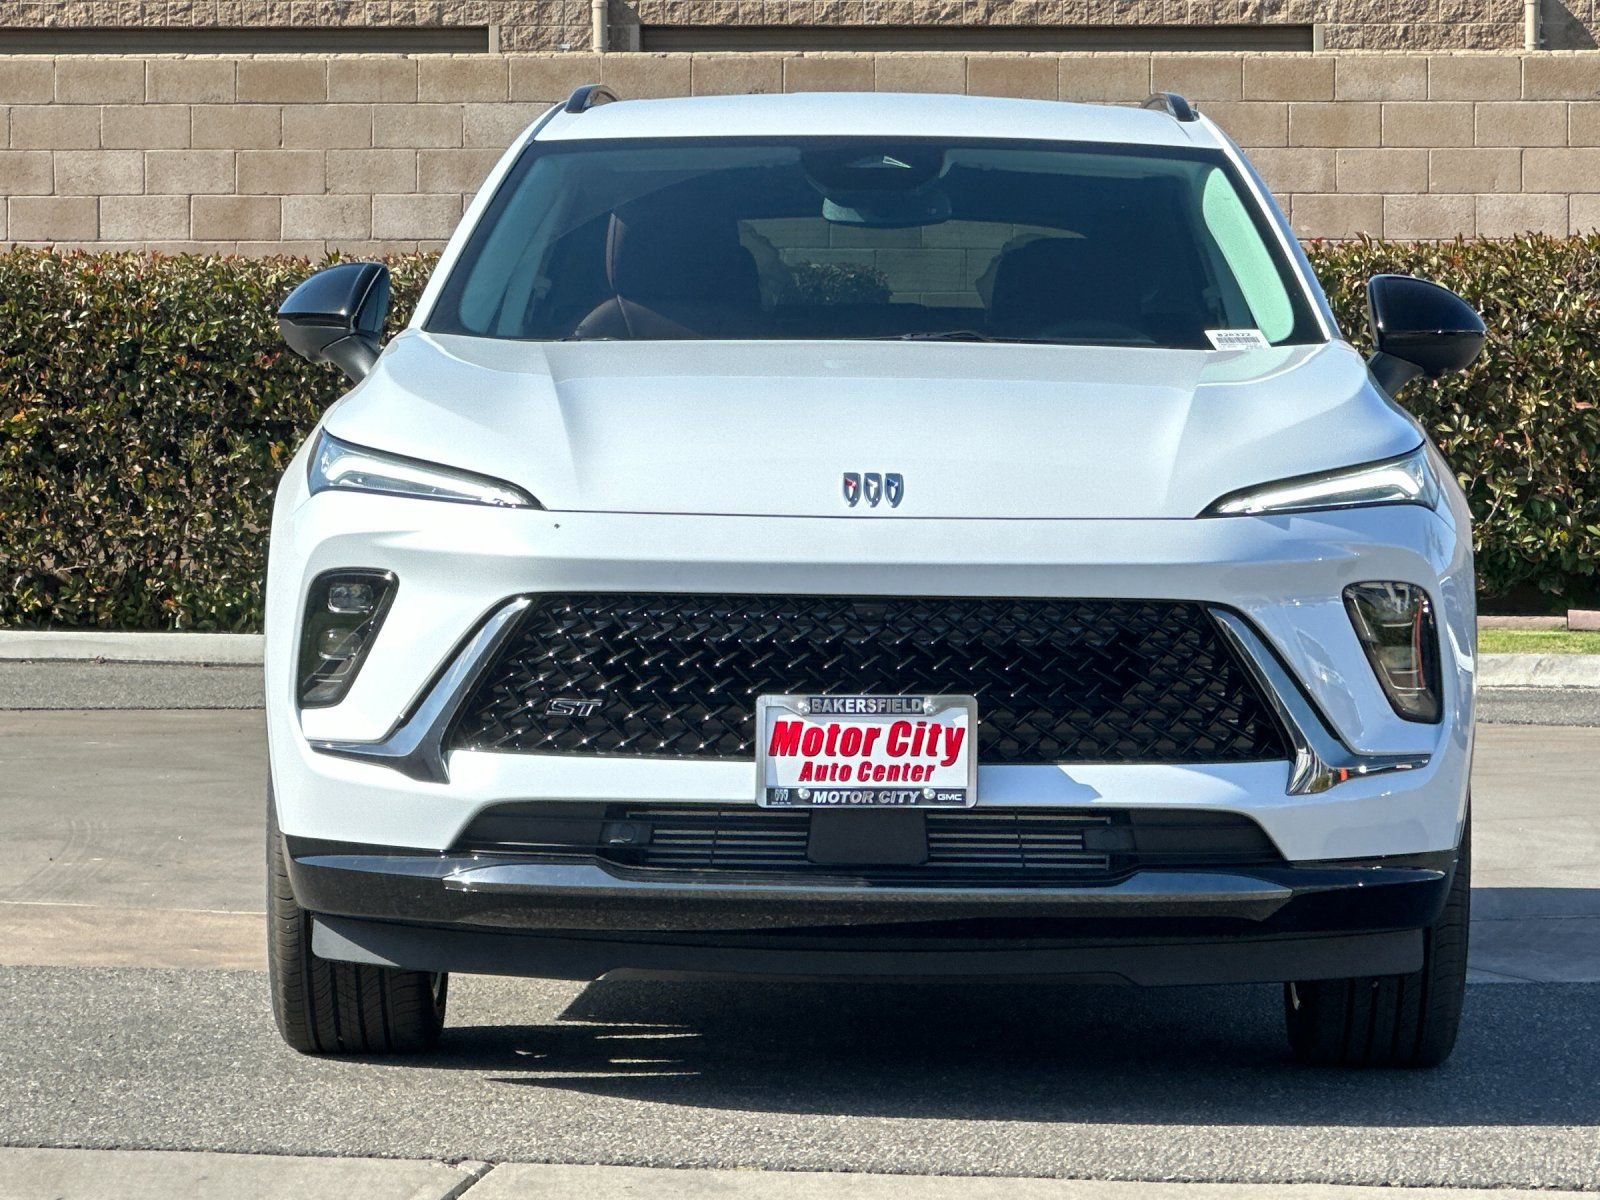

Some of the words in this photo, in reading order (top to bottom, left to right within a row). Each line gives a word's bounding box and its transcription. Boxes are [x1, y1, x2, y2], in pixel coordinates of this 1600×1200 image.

[545, 697, 603, 717] ST
[811, 698, 924, 714] BAKERSFIELD
[768, 720, 881, 757] Motor
[886, 720, 966, 767] City
[798, 761, 851, 782] Auto
[857, 761, 936, 782] Center
[812, 790, 875, 804] MOTOR
[878, 790, 921, 804] CITY
[937, 793, 963, 801] GMC
